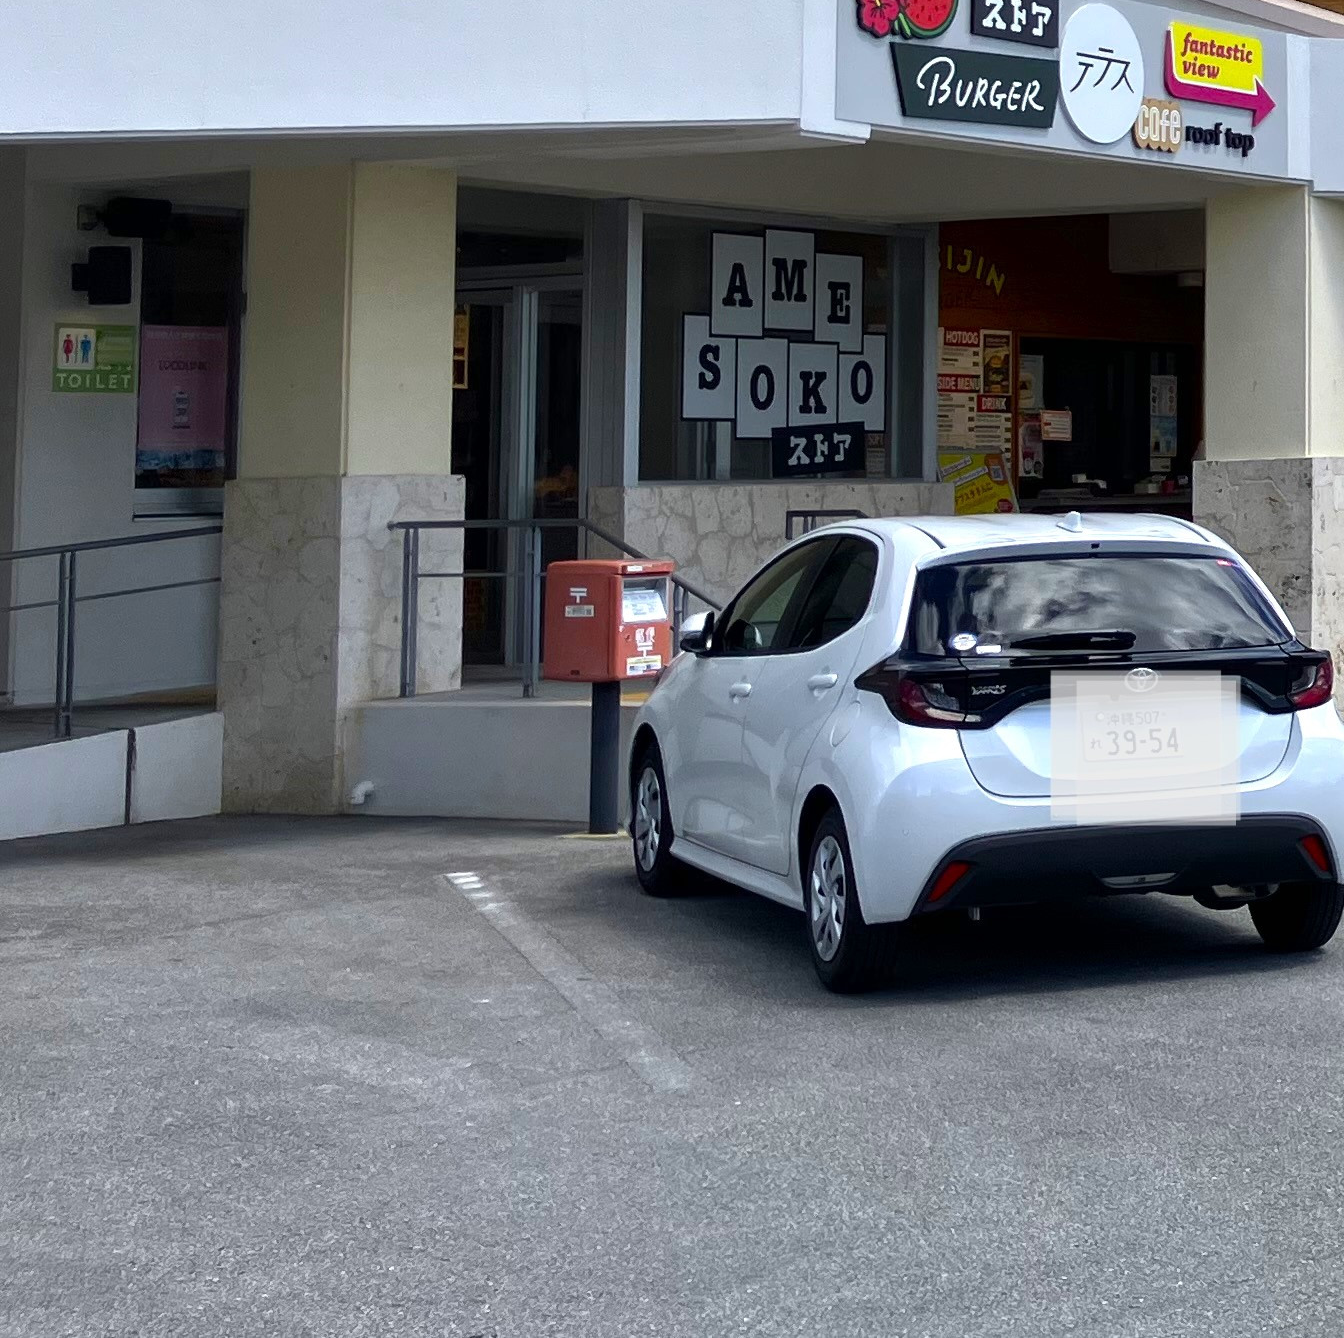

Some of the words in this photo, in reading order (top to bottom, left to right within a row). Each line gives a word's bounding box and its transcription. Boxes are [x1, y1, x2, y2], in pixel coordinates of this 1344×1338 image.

[1180, 31, 1254, 64] fantastic
[915, 55, 1047, 114] BURGER
[1181, 60, 1221, 80] view
[1136, 103, 1182, 149] cafe
[1184, 122, 1223, 147] roof
[1224, 125, 1256, 158] top
[939, 245, 1006, 297] IJIN
[721, 256, 852, 325] AME
[945, 330, 979, 345] HOTDOG
[55, 372, 132, 390] TOILET
[698, 343, 875, 414] SOKO
[937, 376, 956, 390] SIDE
[787, 432, 853, 467] ストア
[1107, 726, 1180, 757] 39-54
